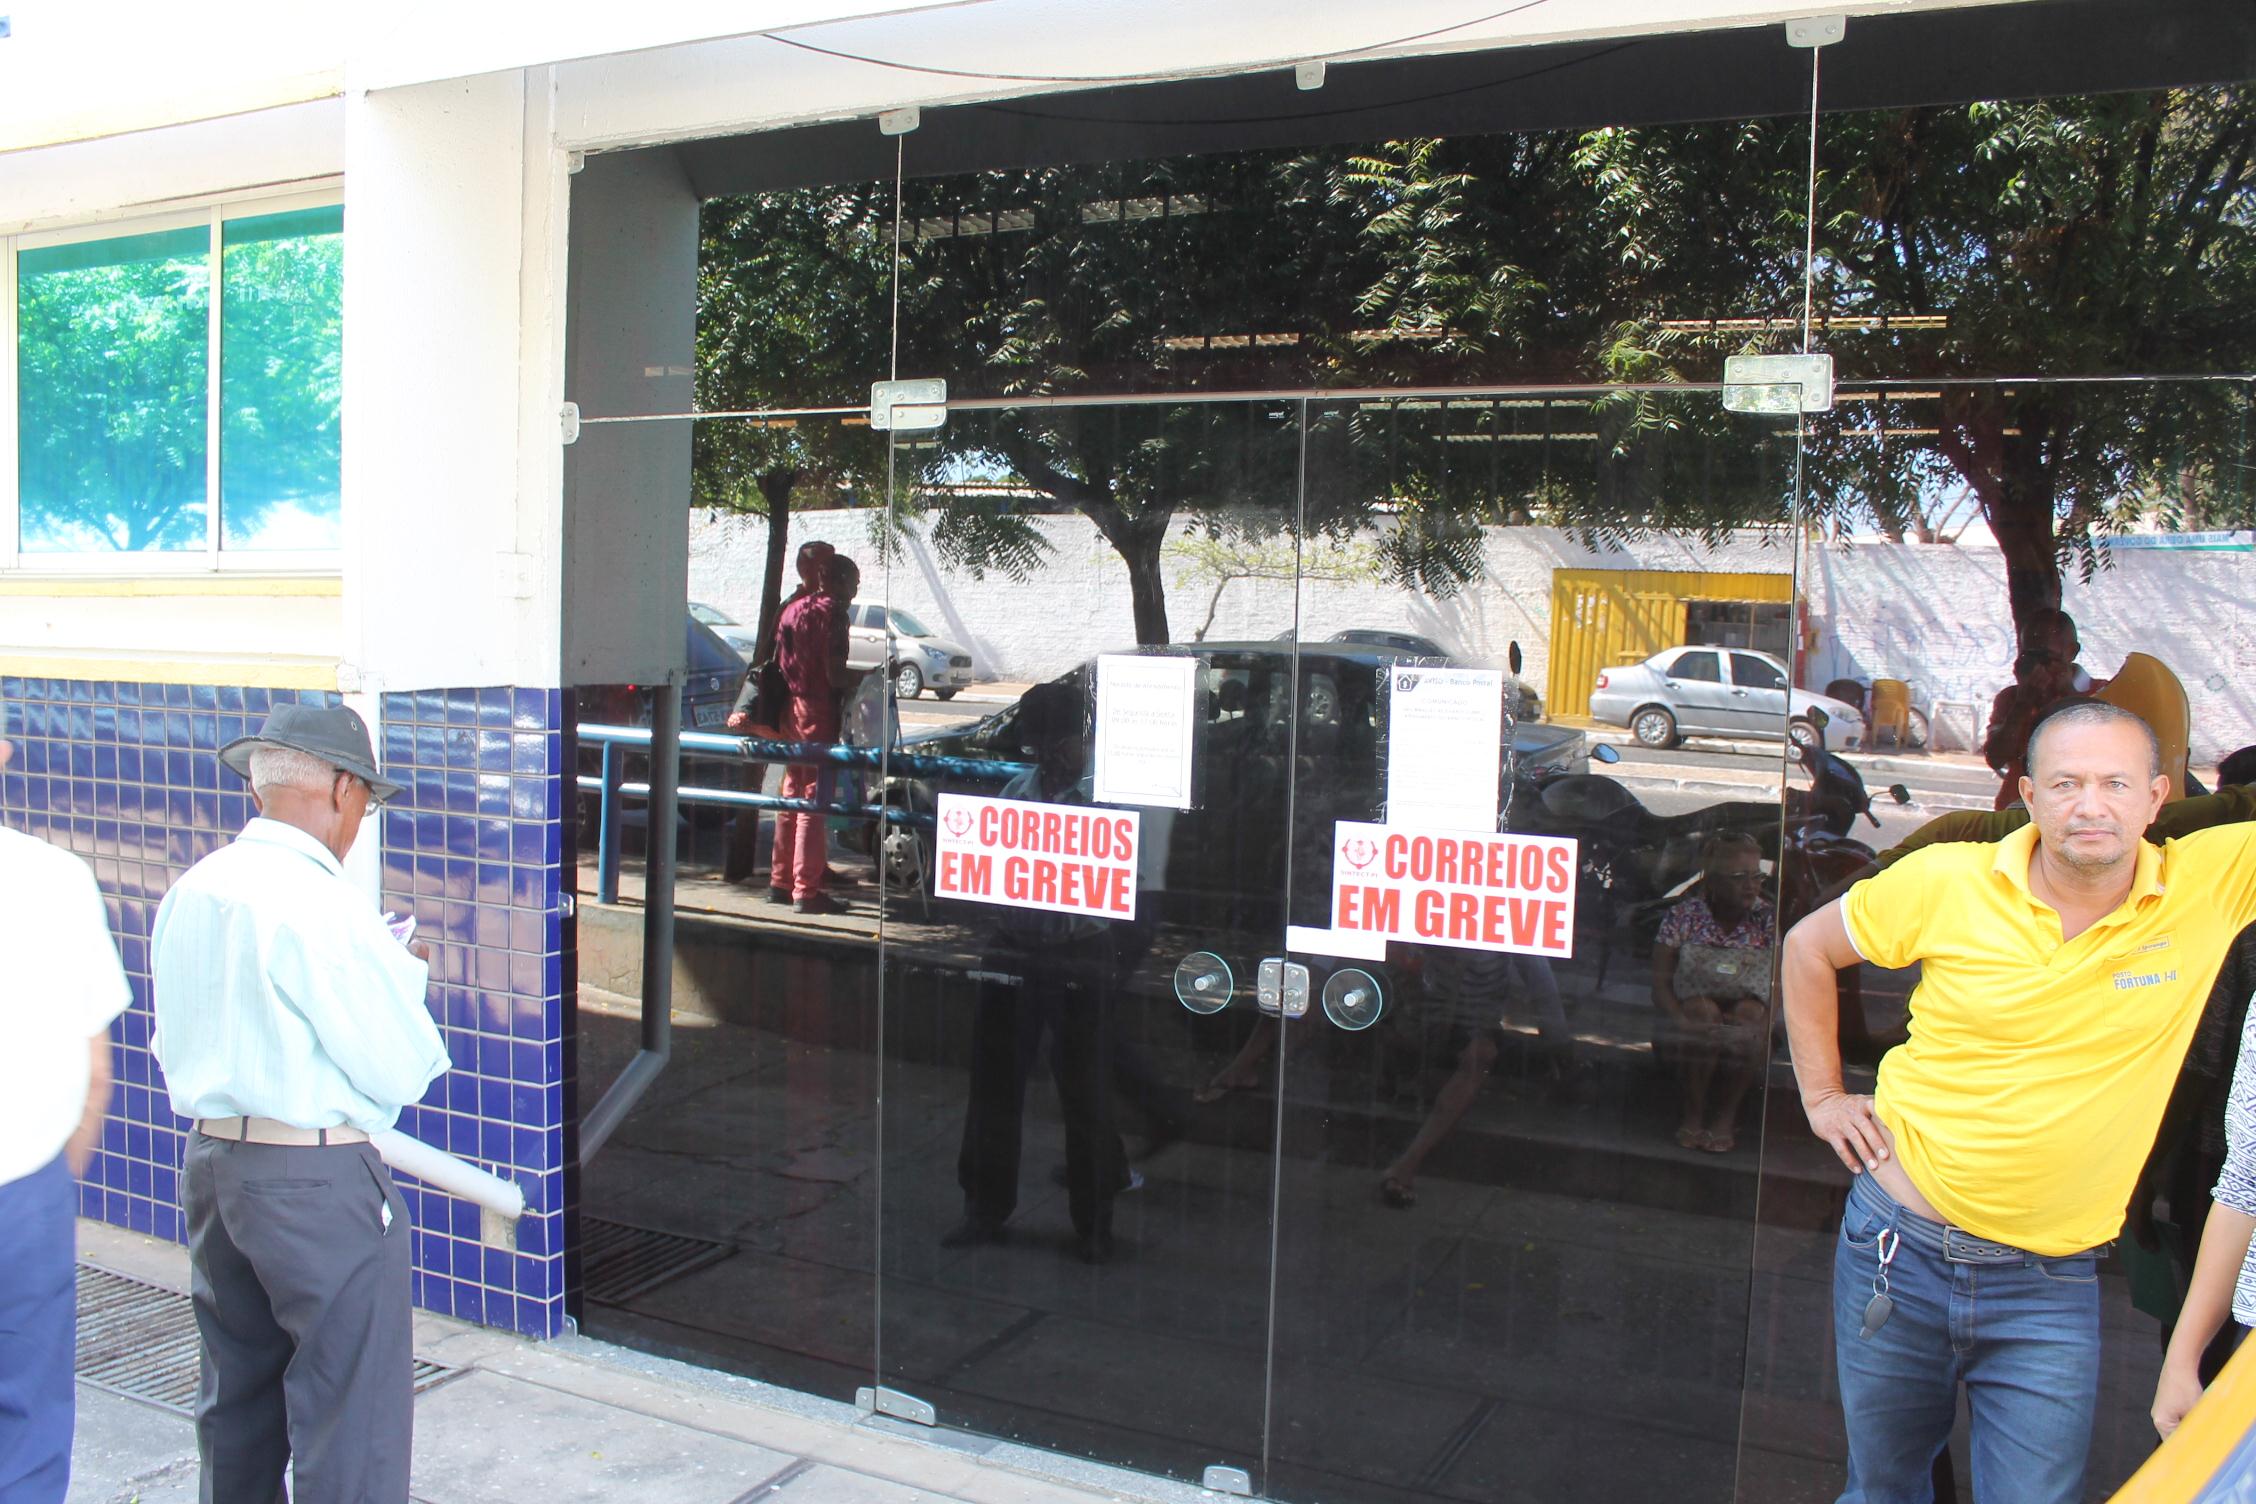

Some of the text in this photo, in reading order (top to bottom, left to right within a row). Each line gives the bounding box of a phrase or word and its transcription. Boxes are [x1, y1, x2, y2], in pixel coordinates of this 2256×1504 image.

[1450, 678, 1471, 686] Banco
[979, 805, 1133, 861] CORREIOS
[940, 851, 1131, 913] EM GREVE
[1385, 834, 1569, 894] CORREIOS
[1338, 884, 1567, 949] EM GREVE
[2112, 971, 2132, 979] POSTO
[2114, 974, 2161, 991] FORTUNA
